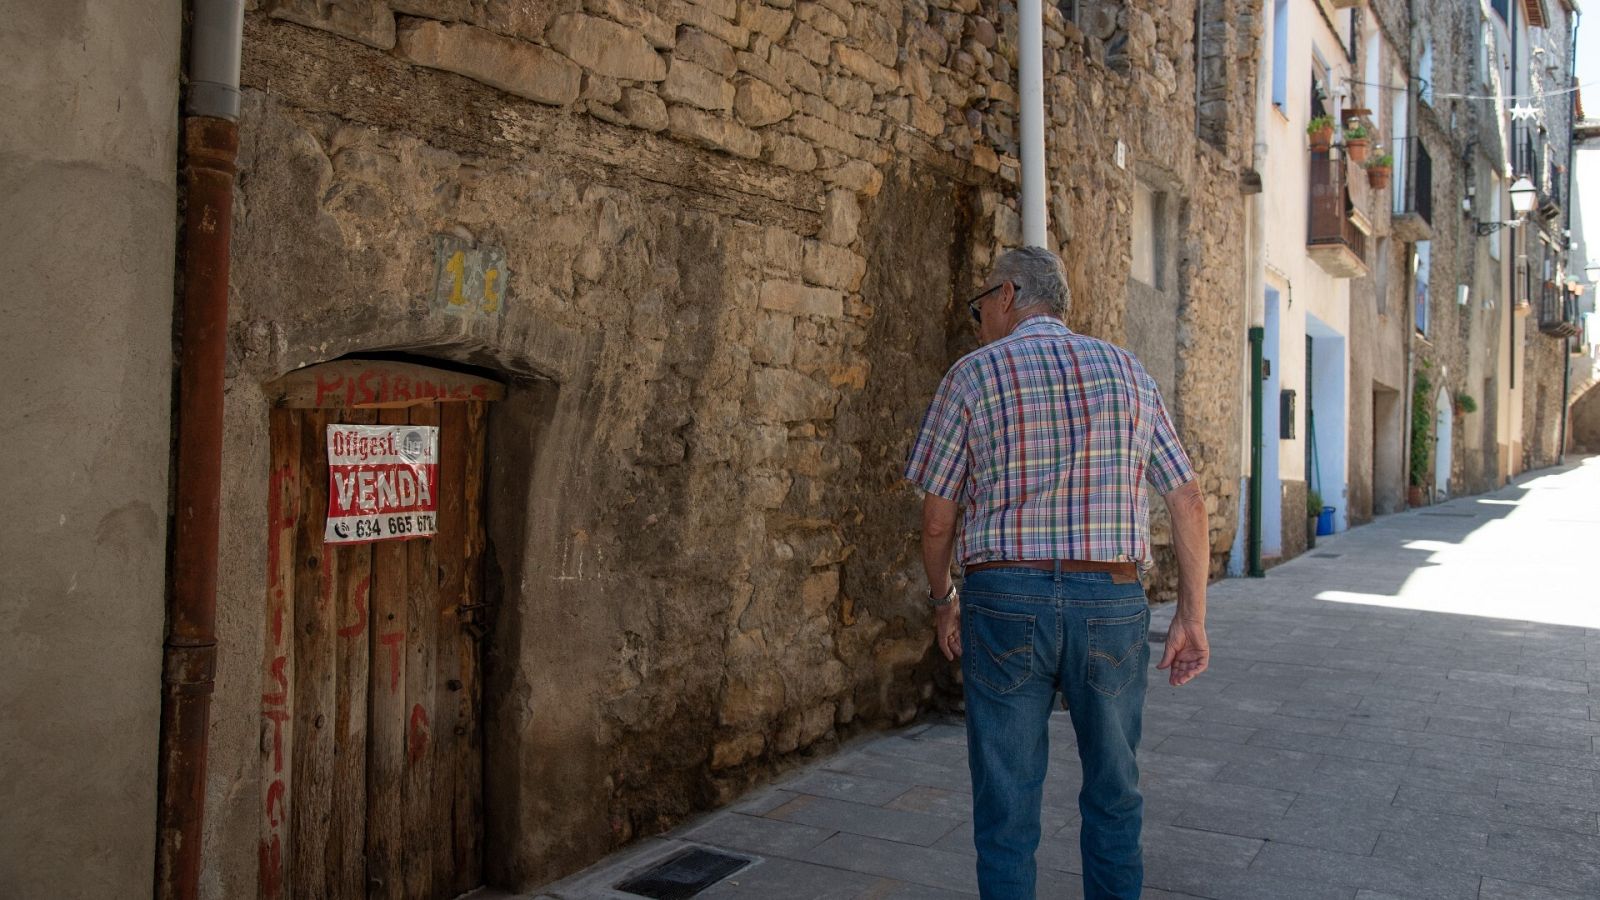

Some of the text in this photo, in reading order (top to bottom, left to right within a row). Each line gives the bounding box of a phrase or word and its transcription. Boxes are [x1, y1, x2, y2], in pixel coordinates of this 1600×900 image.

[334, 468, 432, 511] VENDA
[356, 519, 382, 538] 634
[388, 515, 412, 534] 665
